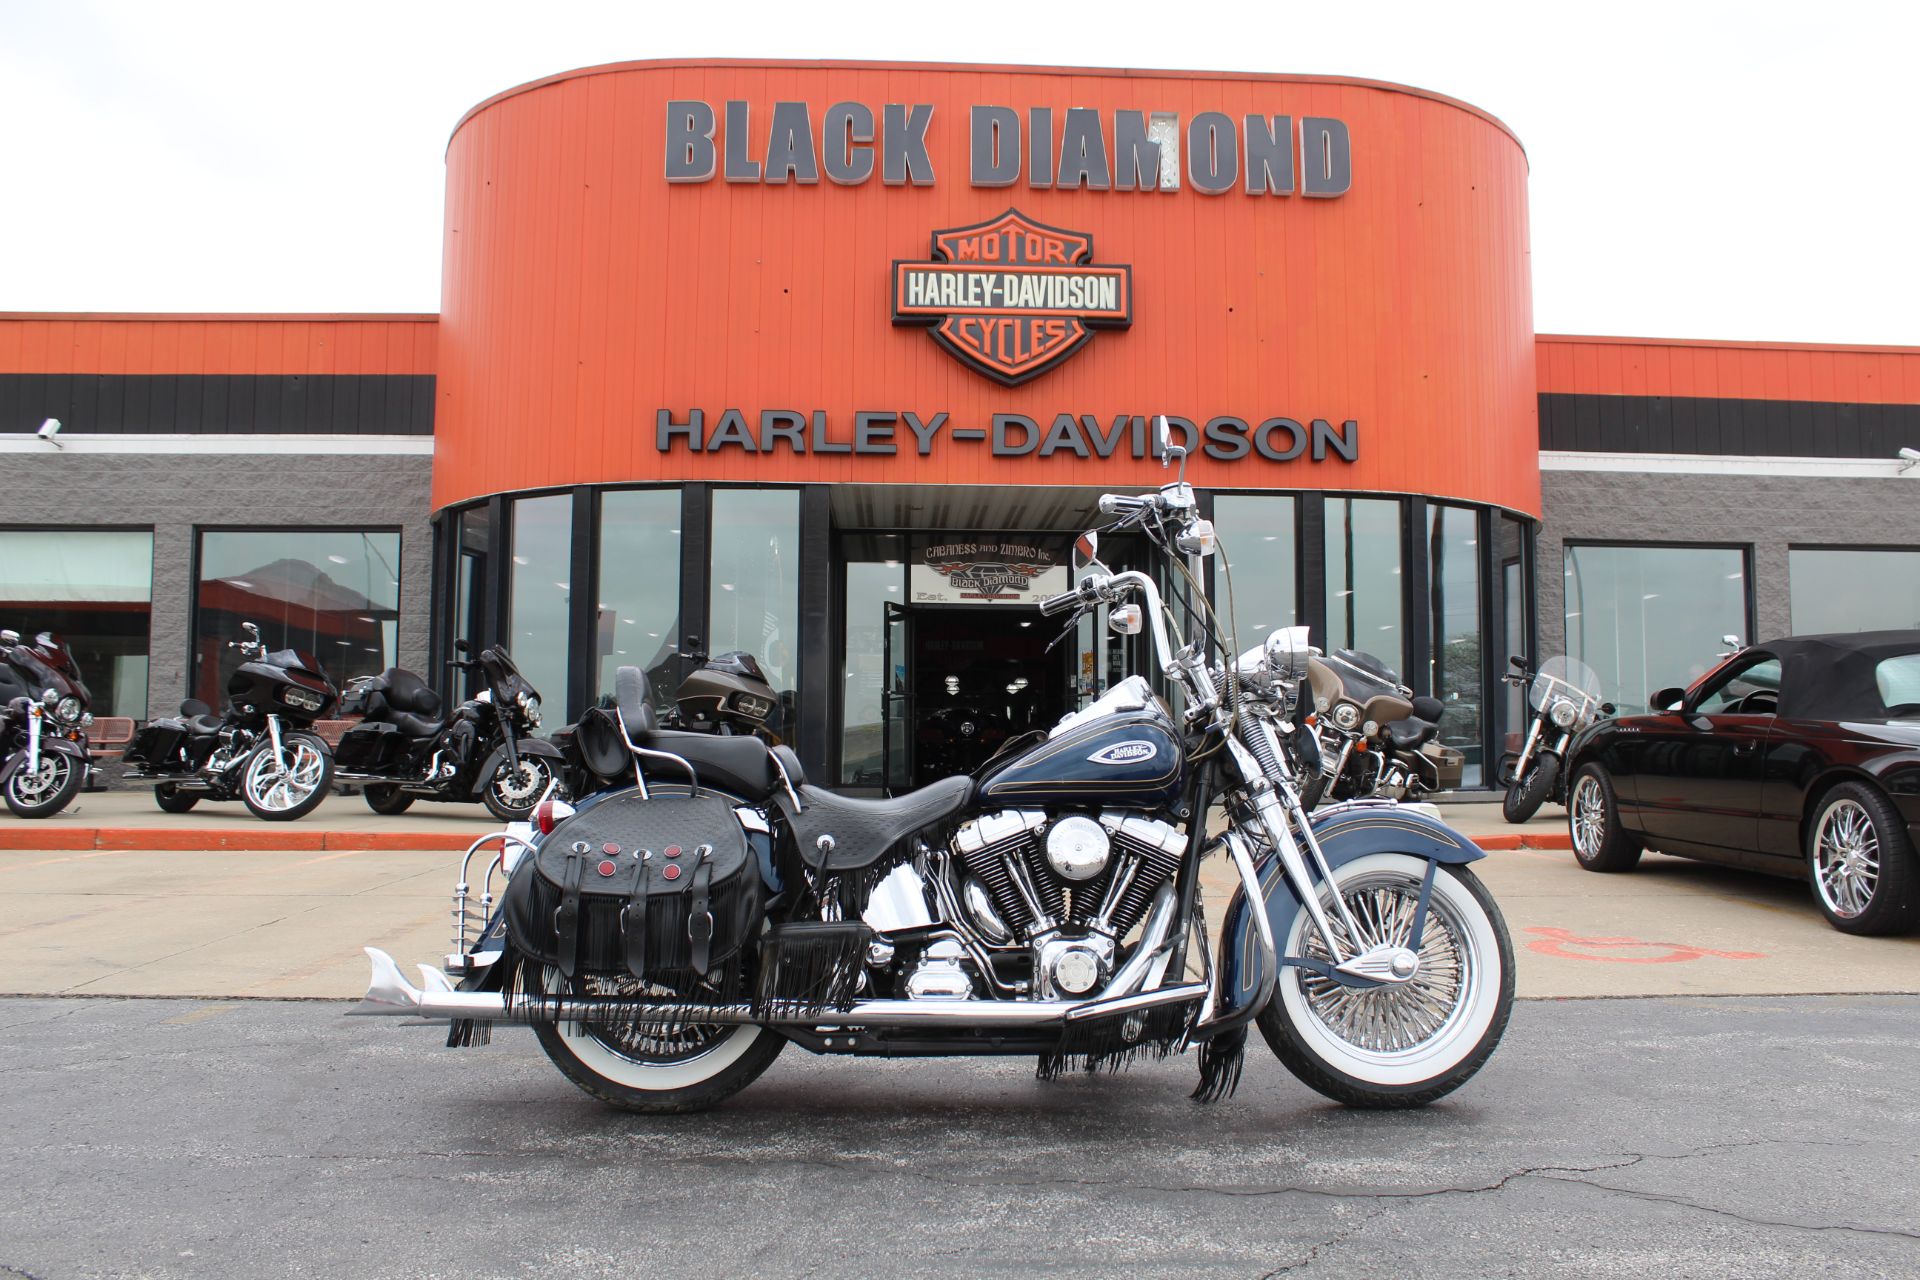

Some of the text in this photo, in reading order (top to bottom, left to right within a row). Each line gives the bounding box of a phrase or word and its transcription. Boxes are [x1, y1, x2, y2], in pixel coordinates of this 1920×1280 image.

[664, 100, 1352, 199] BLACK DIAMOND
[957, 224, 1068, 264] MOTOR
[908, 271, 1116, 311] HARLEY-DAVIDSON
[959, 318, 1066, 365] CYCLES
[656, 408, 1358, 463] HARLEY-DAVIDSON
[916, 592, 948, 601] Est.
